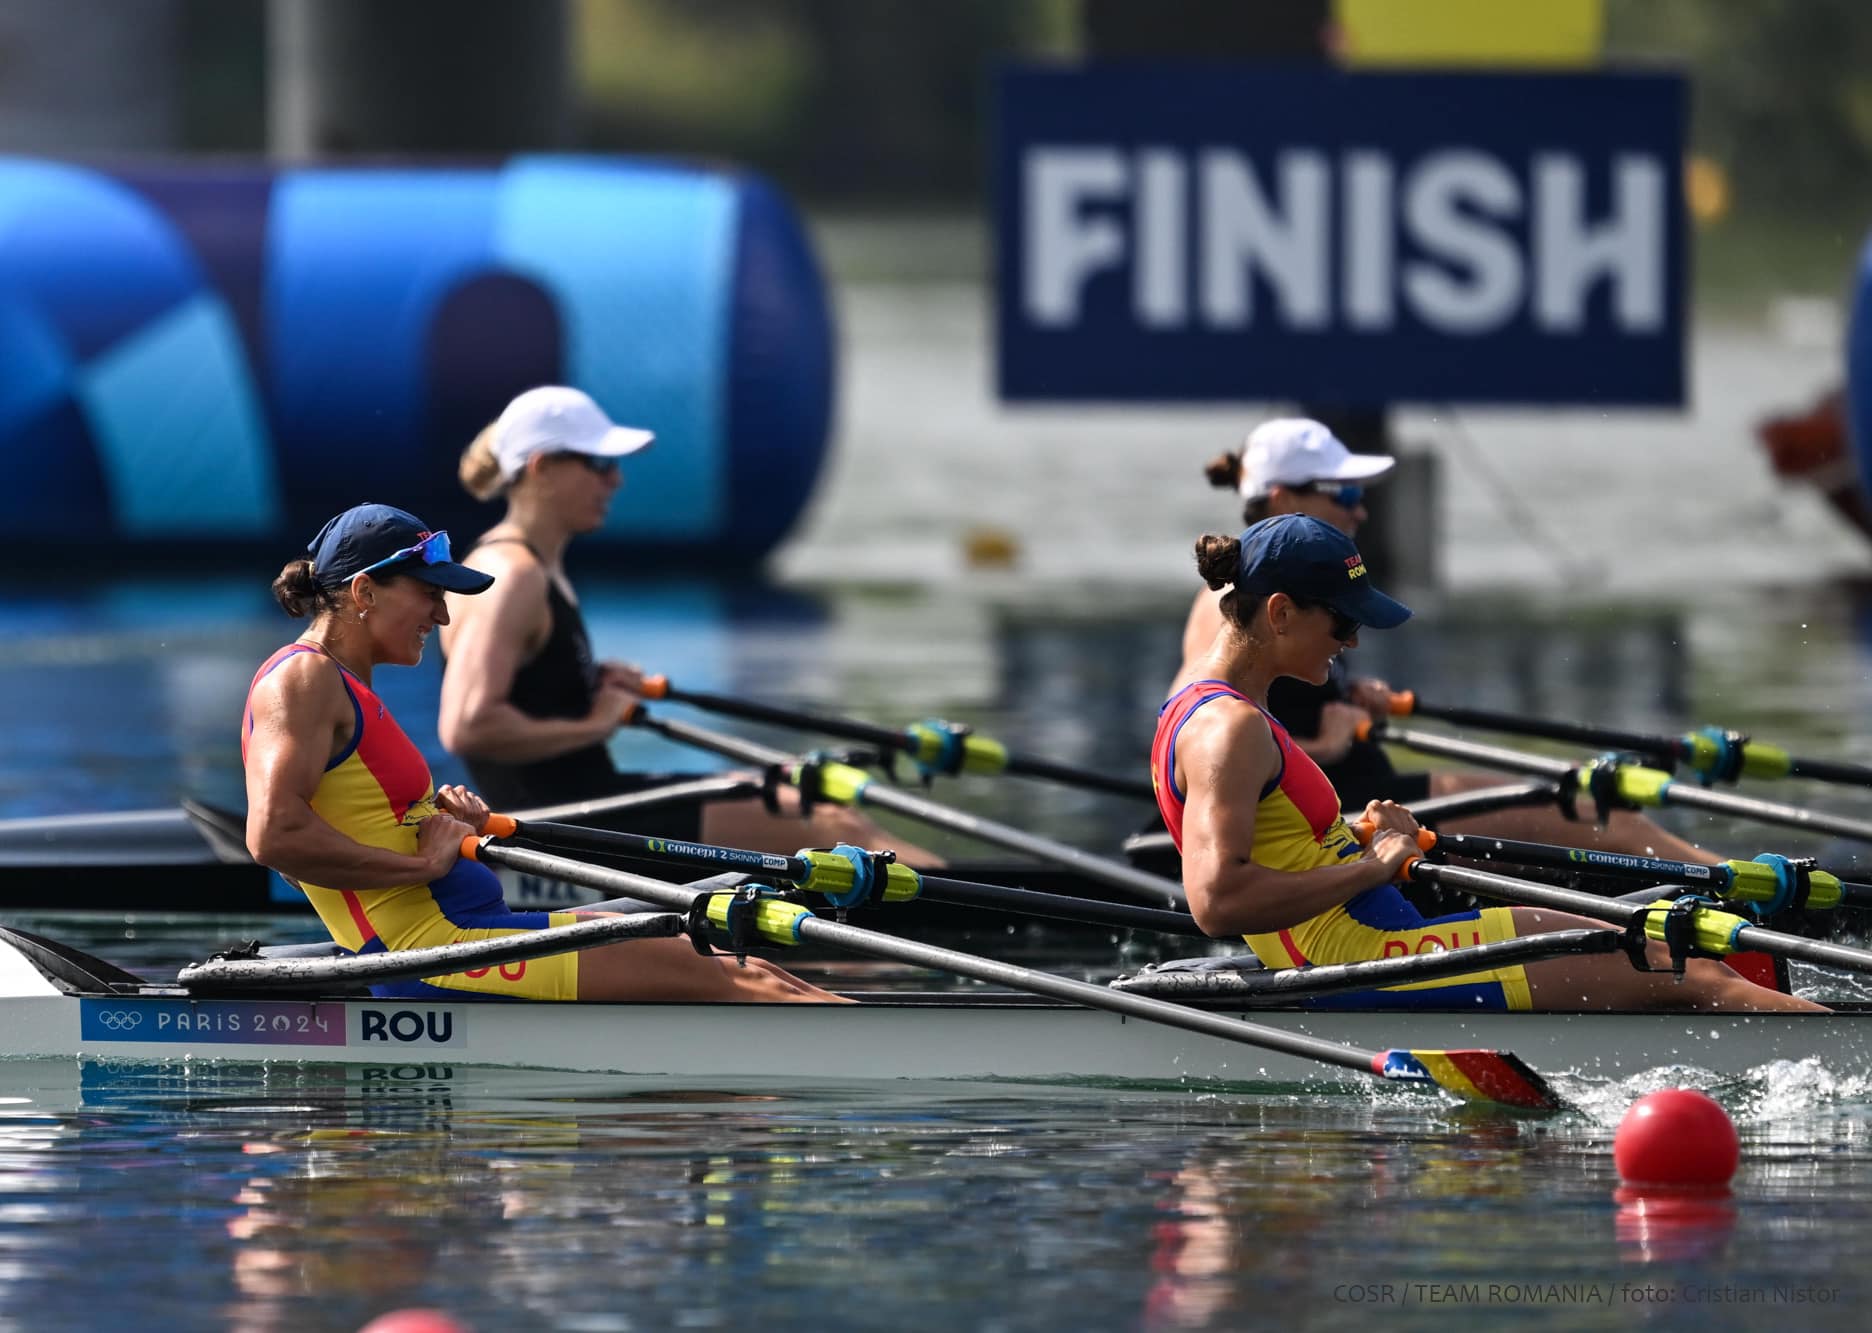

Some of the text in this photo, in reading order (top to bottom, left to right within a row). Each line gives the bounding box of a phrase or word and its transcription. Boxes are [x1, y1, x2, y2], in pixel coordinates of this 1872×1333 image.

[1022, 147, 1665, 333] FINISH
[667, 842, 786, 867] concept 2 SKINNY COMP
[1588, 853, 1709, 876] concept 2 SKINNY COMP
[158, 1012, 328, 1033] PARIS 2024
[361, 1010, 453, 1043] ROU
